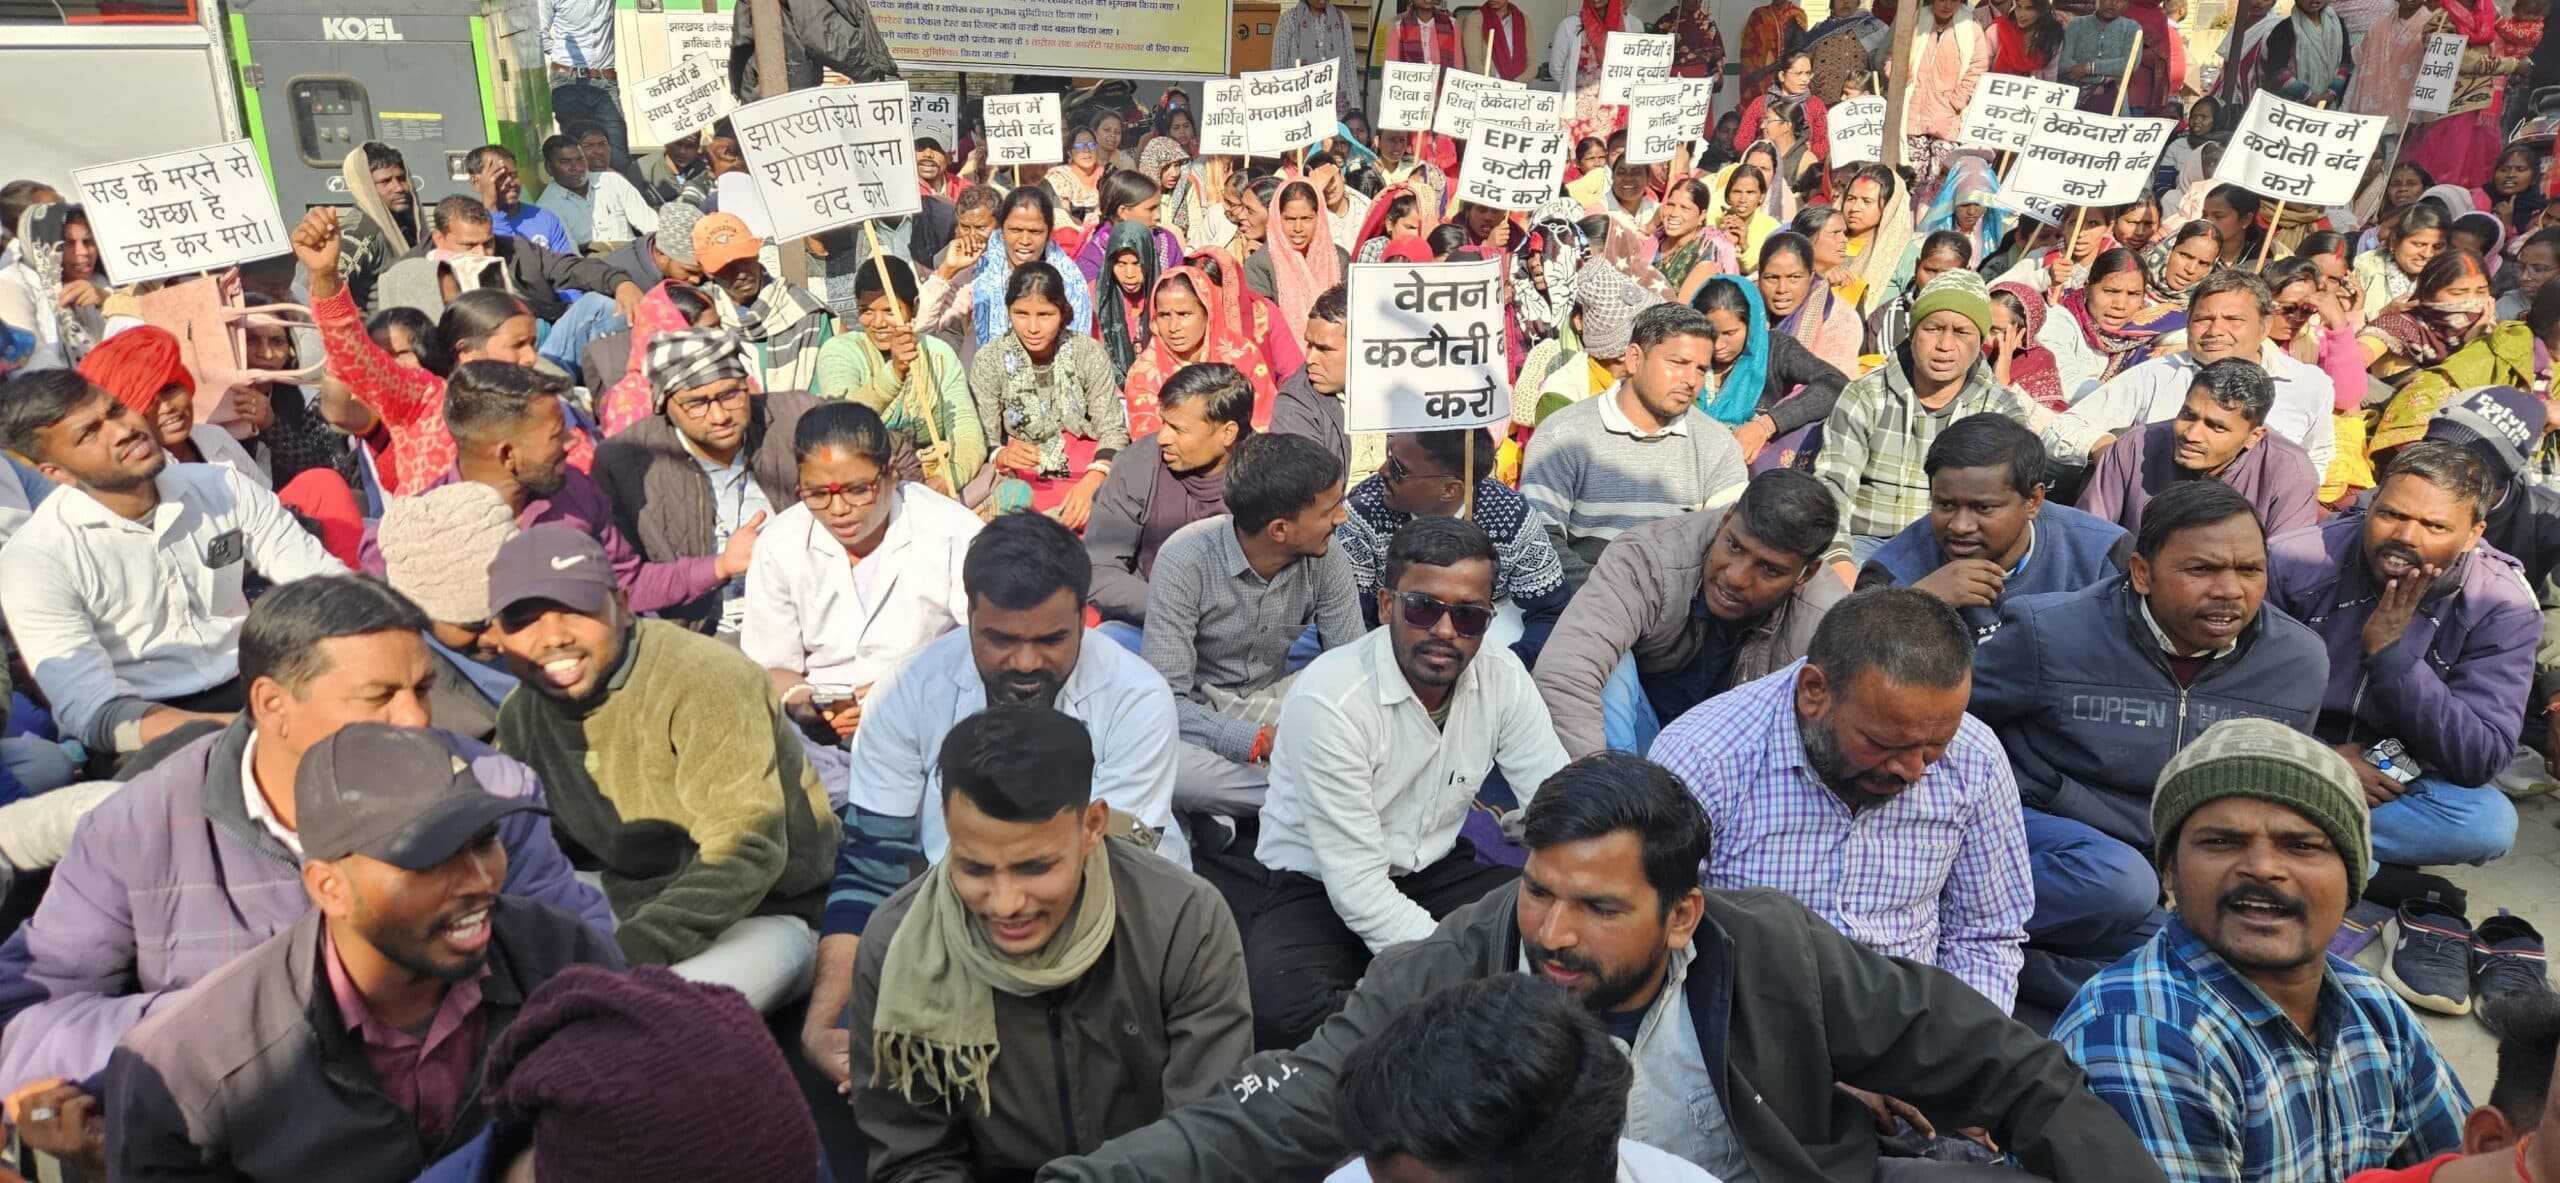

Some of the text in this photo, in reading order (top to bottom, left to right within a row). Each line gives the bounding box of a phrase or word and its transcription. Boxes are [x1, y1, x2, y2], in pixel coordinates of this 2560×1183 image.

[322, 16, 404, 41] KOEL
[2444, 39, 2461, 57] एवं
[688, 63, 701, 79] के
[1249, 64, 1333, 96] ठेकेदारों की
[1607, 64, 1634, 79] साथ
[1389, 84, 1420, 102] शिवा
[1480, 92, 1556, 113] ठेकेदारों की
[1682, 83, 1704, 97] PF
[1988, 79, 2070, 107] EPF में
[644, 103, 673, 122] साथ
[694, 102, 717, 122] करो
[987, 96, 1044, 116] वेतन में
[1248, 95, 1312, 121] मनमानी
[1985, 104, 2036, 125] कटौ
[742, 94, 904, 151] झारखंडियों का
[1284, 120, 1312, 142] करो
[1970, 122, 2008, 143] बंद
[2043, 115, 2134, 145] ठेकेदारों
[2133, 122, 2164, 144] की
[2268, 103, 2369, 142] वेतन में
[1000, 141, 1032, 160] करो
[1483, 128, 1564, 155] EPF में
[2242, 130, 2365, 172] कटौती बंद
[762, 139, 903, 187] शोषण करना
[1482, 156, 1553, 181] कटौती
[2026, 143, 2155, 172] मनमानी बंद
[82, 147, 254, 207] सड़ के मरने से
[2062, 178, 2109, 199] करो
[2261, 171, 2315, 197] करो
[806, 171, 890, 218] बंद करो
[1469, 178, 1552, 205] बंद करो
[137, 187, 226, 230] अच्छा है
[120, 239, 169, 268] लड़
[171, 232, 212, 258] कर
[1393, 269, 1490, 313] वेतन
[1362, 320, 1491, 369] कटौती
[1424, 374, 1497, 420] करो
[2476, 392, 2532, 441] Calvin
[2476, 405, 2523, 448] Klein
